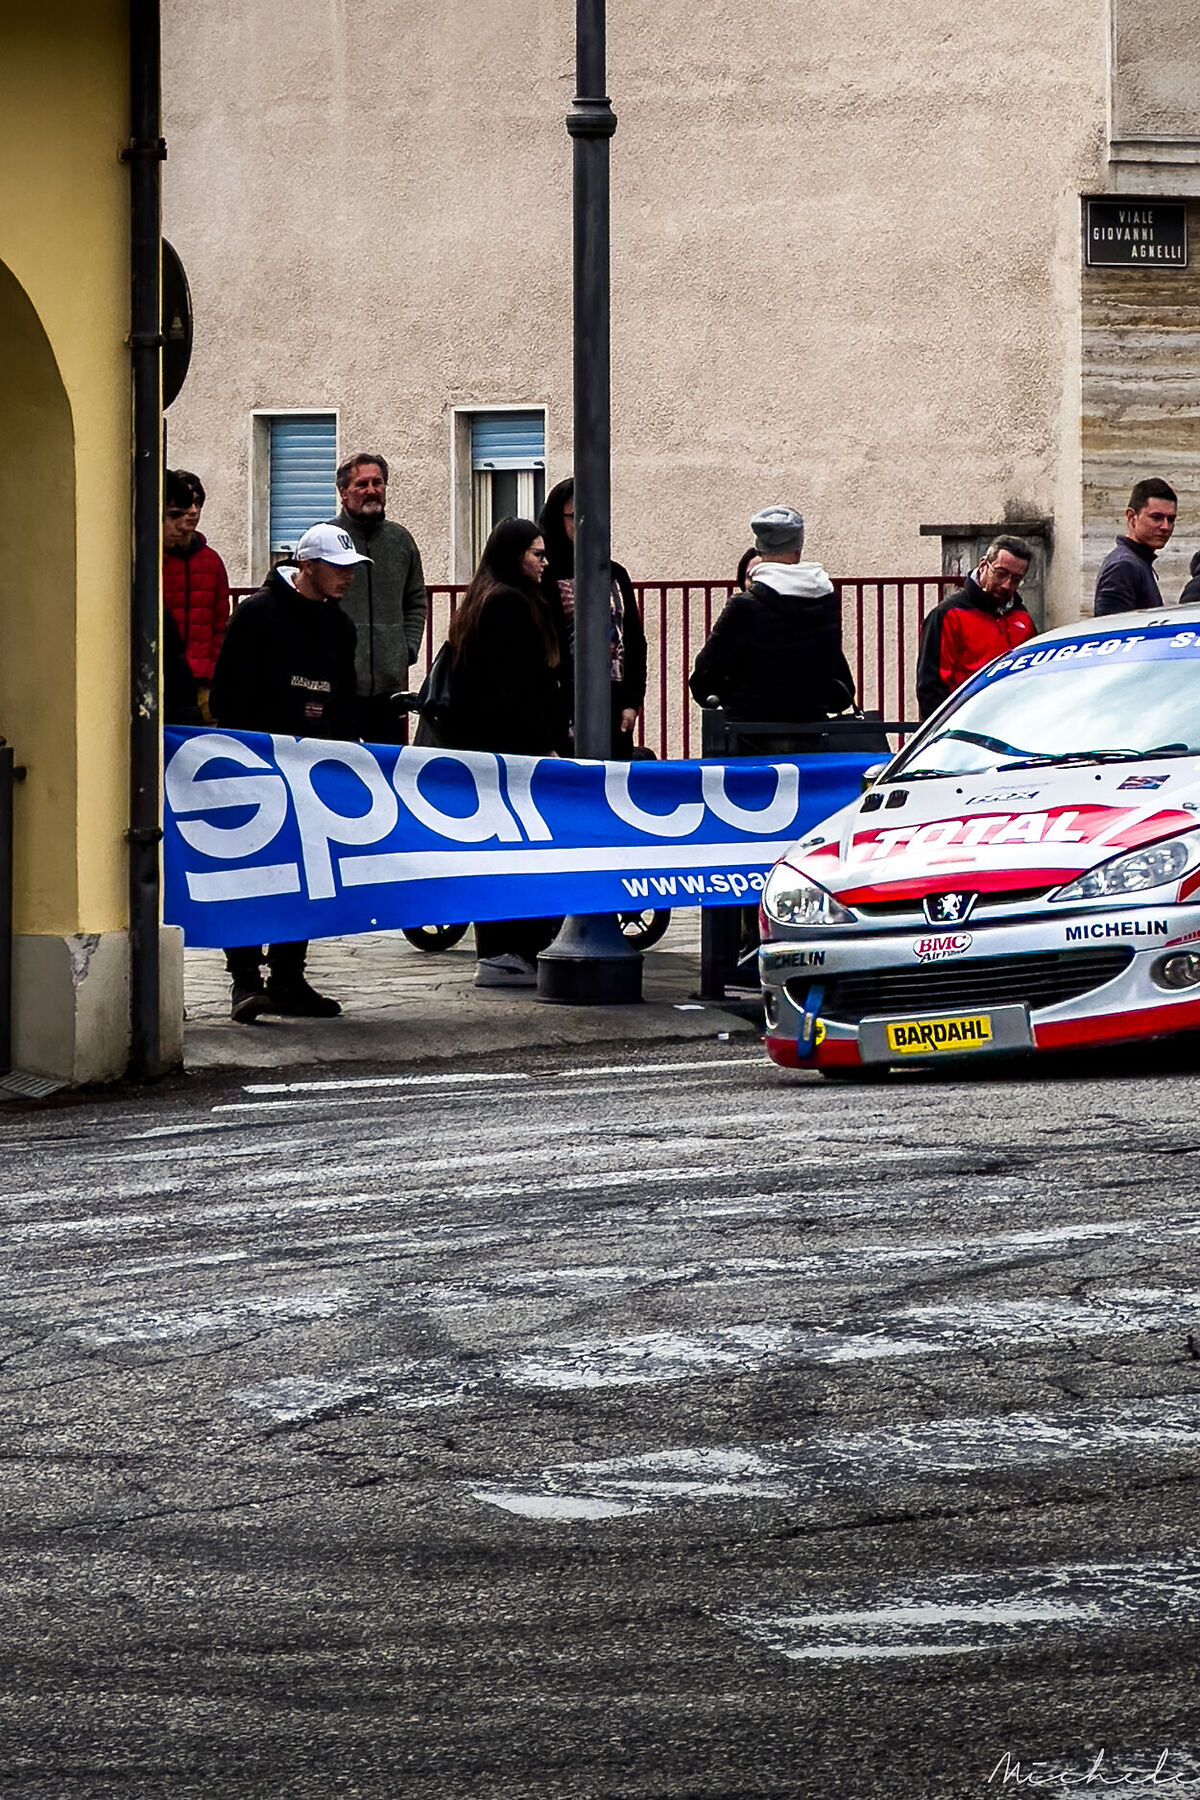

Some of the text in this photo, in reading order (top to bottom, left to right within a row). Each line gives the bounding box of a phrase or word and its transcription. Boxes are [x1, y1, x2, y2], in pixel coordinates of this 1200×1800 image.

[1119, 210, 1153, 224] VIALE
[1093, 227, 1154, 241] GIOVANNI
[1131, 244, 1181, 258] AGNELLI
[986, 635, 1146, 678] PEUGEOT
[872, 810, 1085, 861] TOTAL
[621, 871, 772, 898] www.spa
[1065, 919, 1168, 942] MICHELIN
[918, 935, 967, 954] BMC
[893, 1019, 989, 1051] BARDAHL
